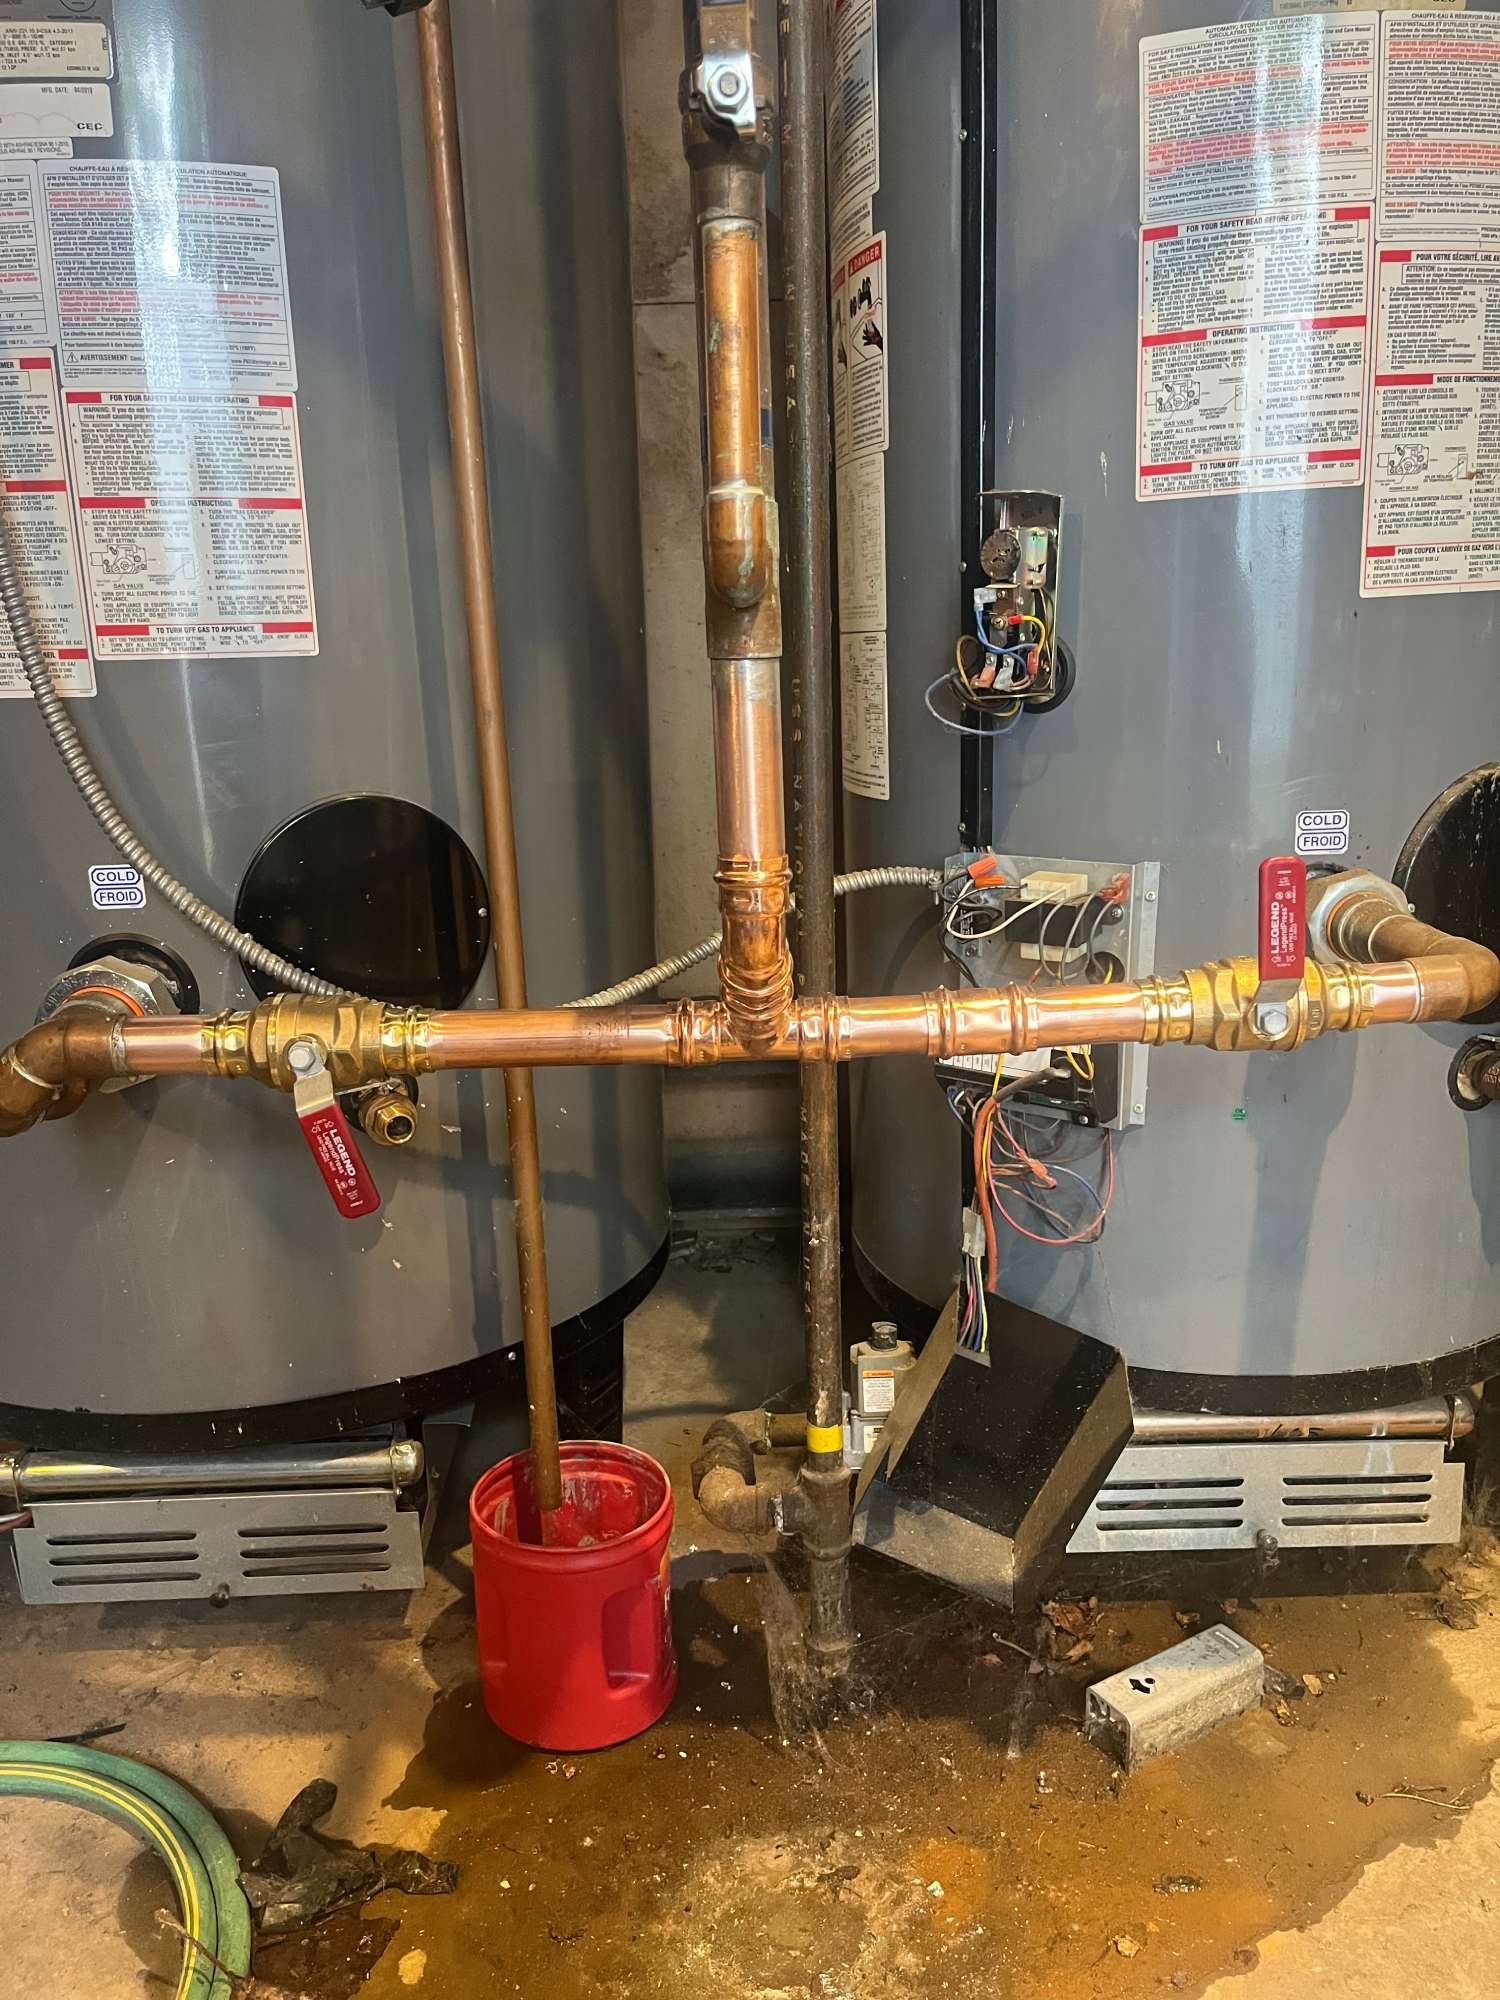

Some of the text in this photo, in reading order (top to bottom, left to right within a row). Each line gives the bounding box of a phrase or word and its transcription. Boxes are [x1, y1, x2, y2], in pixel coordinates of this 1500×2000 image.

[1205, 25, 1238, 34] AUTOMATIC
[1208, 30, 1247, 39] CIRCULATING
[1186, 225, 1199, 233] FOR
[1201, 222, 1218, 232] YOUR
[1220, 220, 1244, 229] SAFETY
[854, 246, 880, 269] DANGER
[1212, 328, 1248, 338] OPERATING
[1210, 462, 1226, 470] TURN
[1228, 460, 1240, 468] OFF
[1397, 548, 1412, 556] POUR
[1302, 814, 1342, 826] COLD
[1304, 836, 1341, 846] FROID
[96, 872, 135, 882] COLD
[100, 892, 138, 902] FROID
[1270, 901, 1280, 954] LEGEND
[329, 1128, 356, 1176] LEGEND
